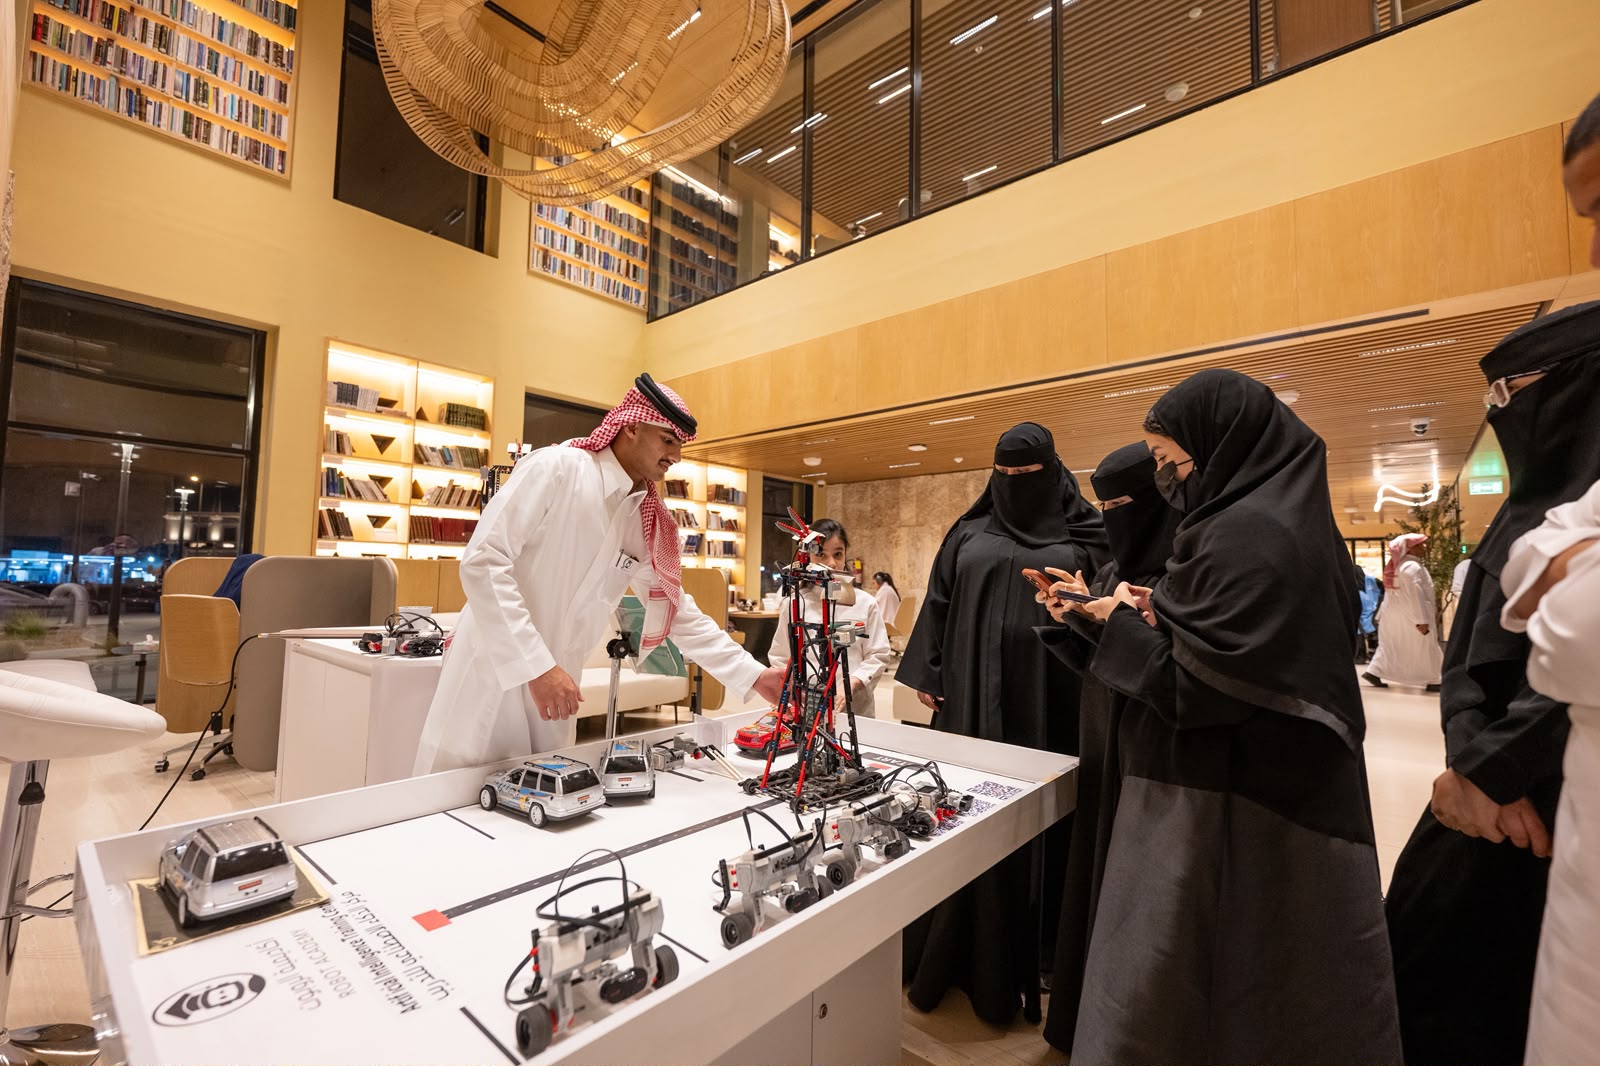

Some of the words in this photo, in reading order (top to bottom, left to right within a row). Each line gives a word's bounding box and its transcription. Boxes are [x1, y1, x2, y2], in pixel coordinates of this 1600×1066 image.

[873, 756, 912, 769] TART
[330, 914, 359, 943] Training
[291, 929, 329, 965] ACADEMY
[349, 938, 391, 980] Intelligence
[319, 966, 356, 999] ROBOT
